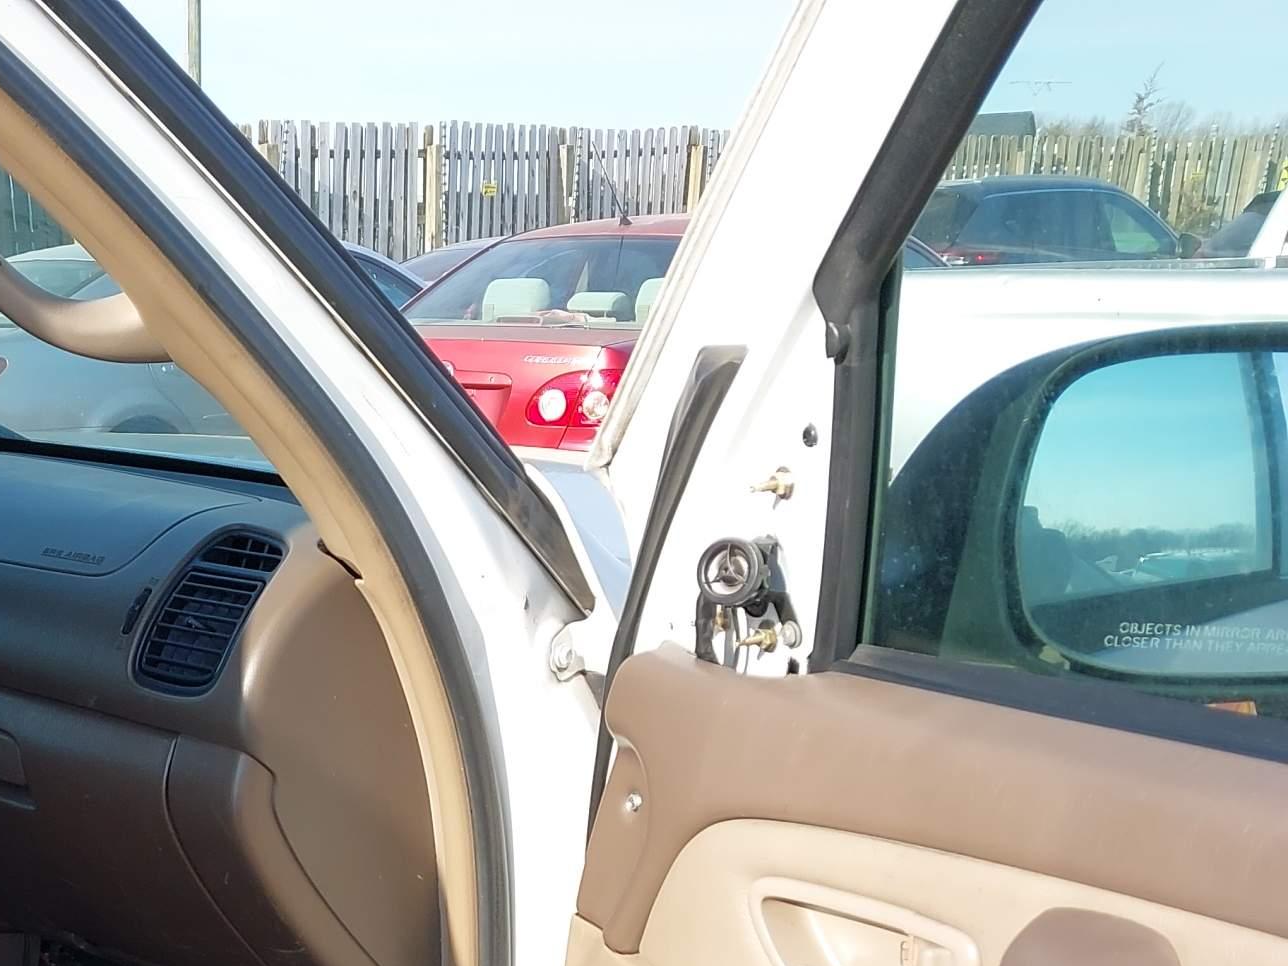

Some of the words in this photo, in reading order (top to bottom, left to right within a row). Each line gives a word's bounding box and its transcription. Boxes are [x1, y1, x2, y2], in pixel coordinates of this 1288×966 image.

[1119, 621, 1182, 636] OBJECTS
[1185, 624, 1200, 637] IN
[1201, 625, 1262, 641] MIRROR
[1264, 627, 1288, 641] AR
[1103, 635, 1160, 648] CLOSER
[1164, 638, 1202, 649] THAN
[1207, 640, 1244, 652] THEY
